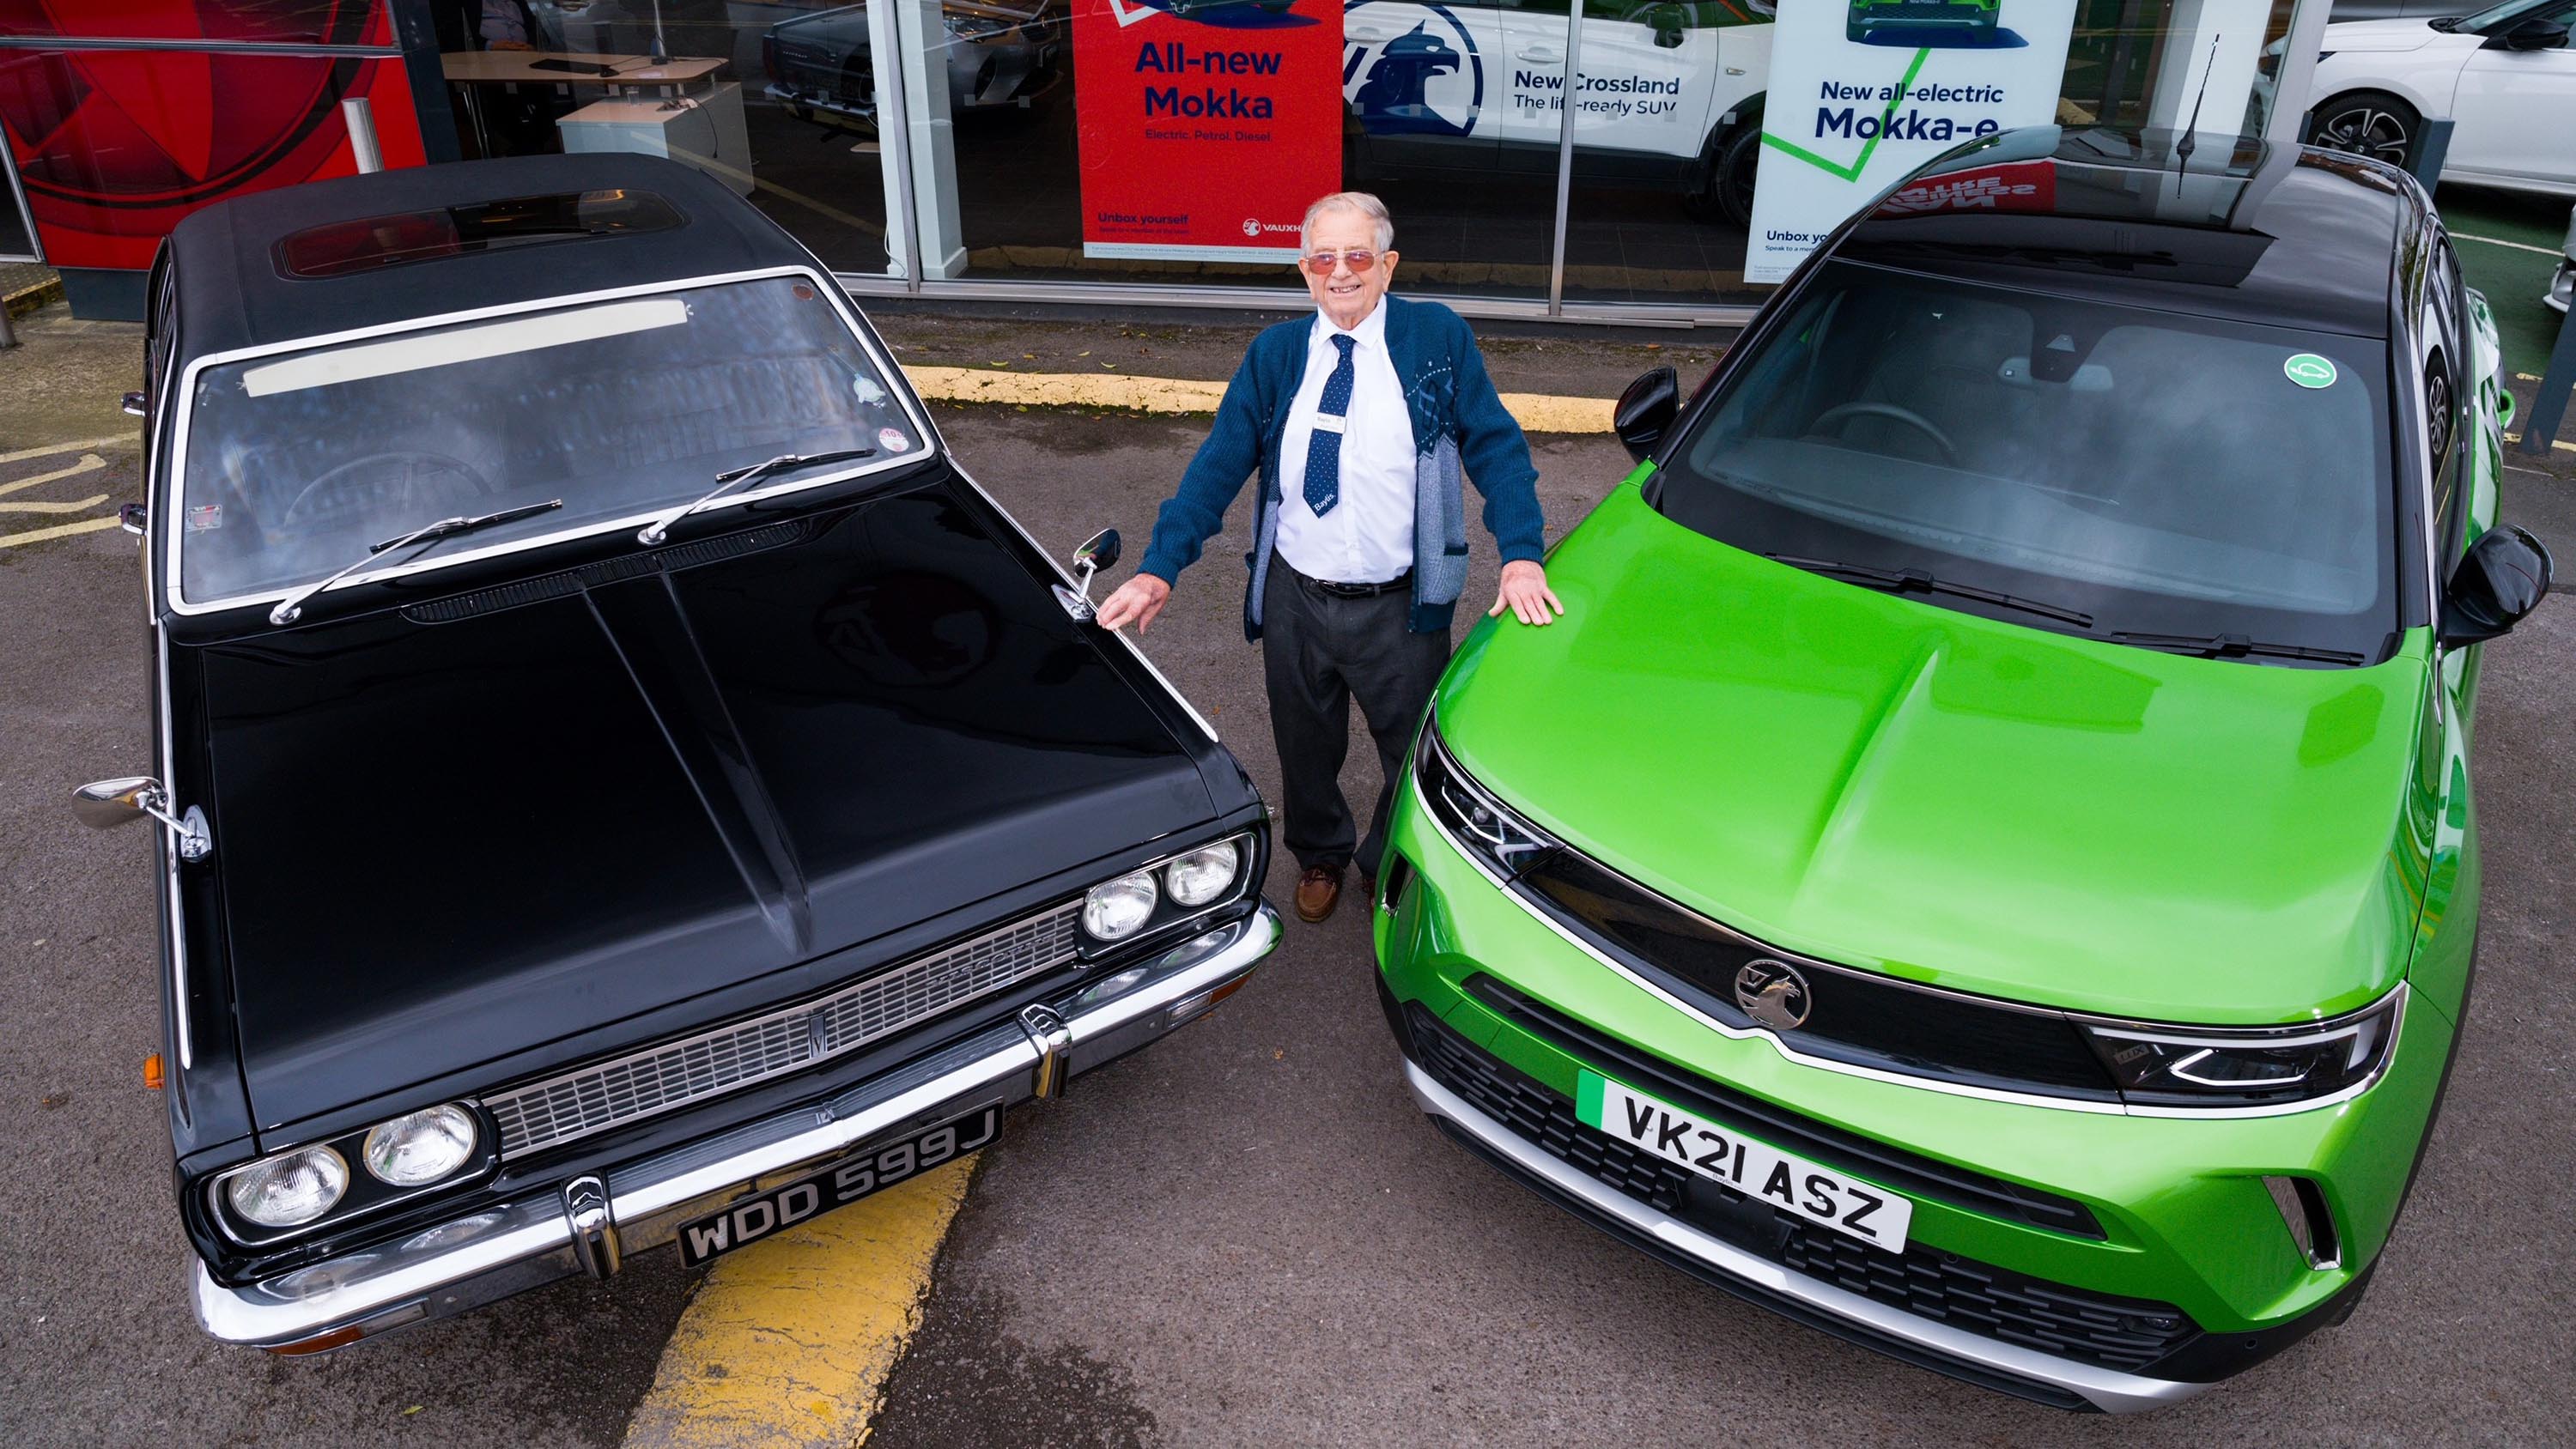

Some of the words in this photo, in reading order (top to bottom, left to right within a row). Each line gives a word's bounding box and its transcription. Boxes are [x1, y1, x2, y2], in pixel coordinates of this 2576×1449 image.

[1135, 41, 1282, 75] All-new
[1515, 70, 1564, 89] New
[1145, 87, 1273, 119] Mokka
[1820, 81, 1874, 100] New
[1879, 82, 2004, 103] all-electric
[1514, 94, 1546, 109] The
[1636, 100, 1677, 114] SUV
[1814, 106, 2000, 141] Mokka-e
[1098, 212, 1137, 222] Unbox
[1140, 214, 1188, 225] yourself
[1766, 230, 1808, 241] Unbox
[1812, 233, 1827, 245] yo
[1314, 493, 1334, 512] Baylis
[1624, 1095, 1747, 1184] VK21
[1761, 1160, 1884, 1237] ASZ
[688, 1183, 819, 1259] WDD
[835, 1109, 996, 1202] 599J
